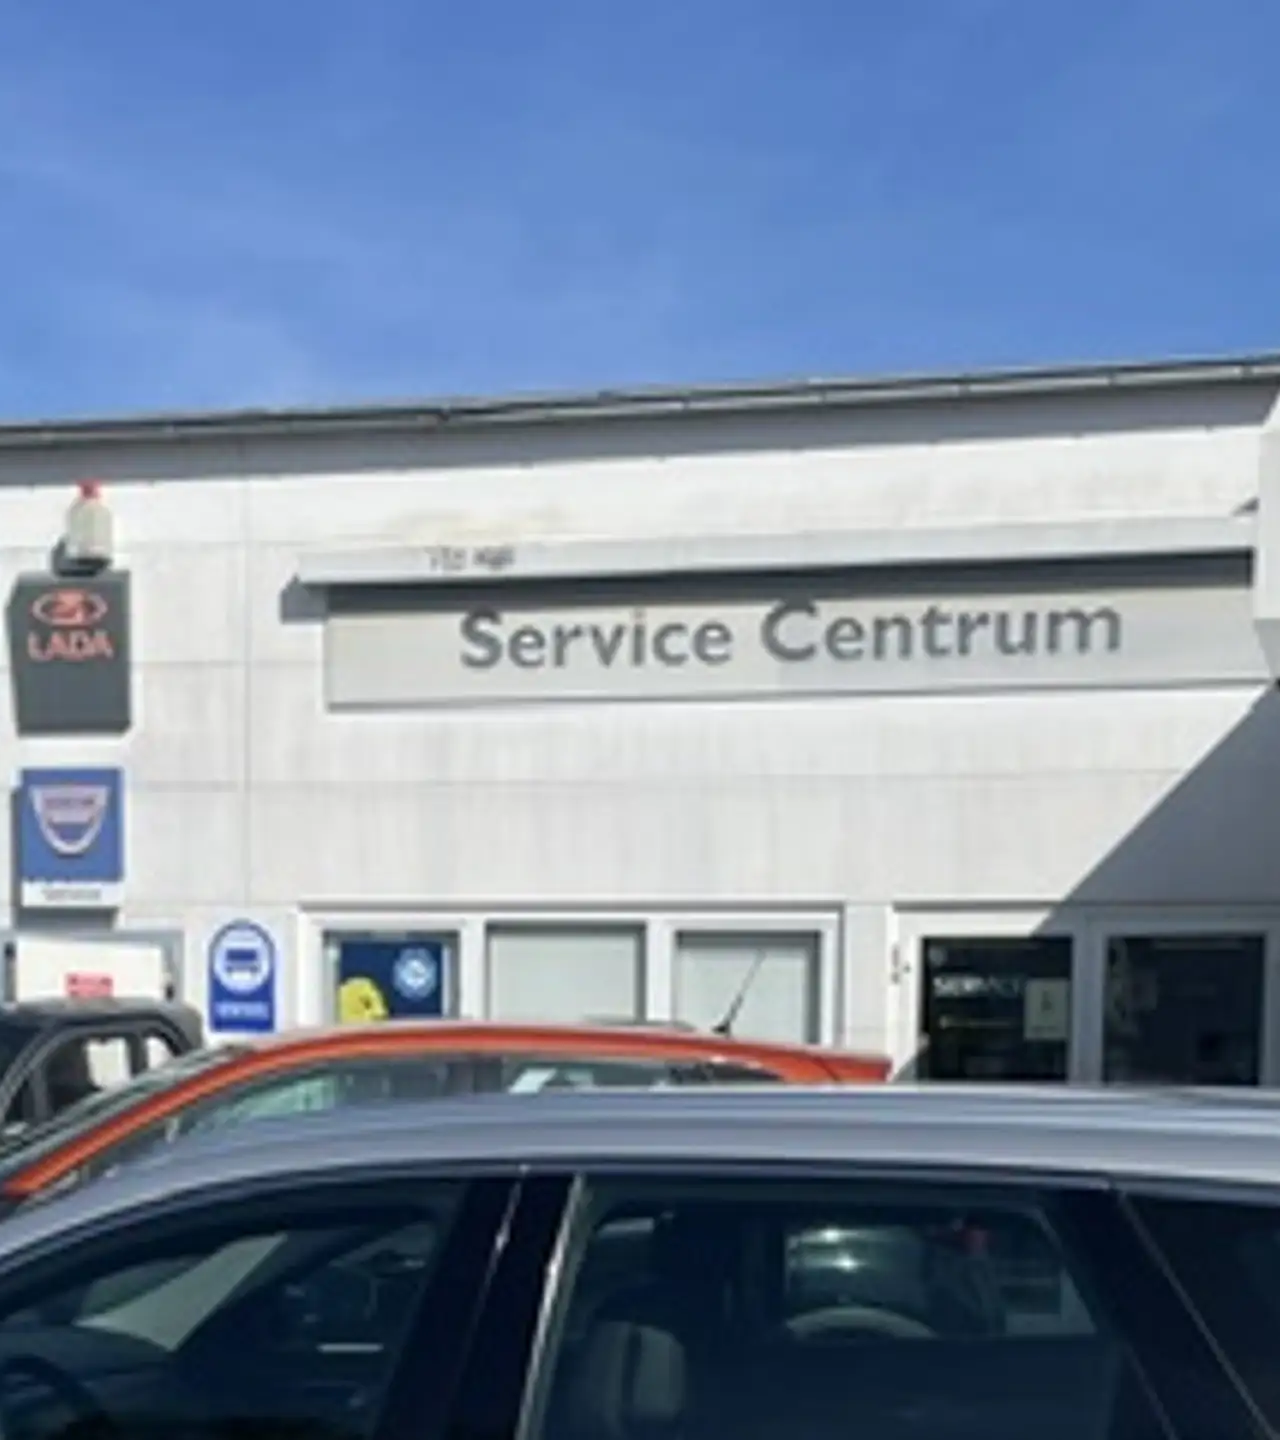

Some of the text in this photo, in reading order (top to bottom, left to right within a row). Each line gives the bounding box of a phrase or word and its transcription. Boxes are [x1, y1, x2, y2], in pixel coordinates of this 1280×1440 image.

[27, 629, 115, 662] LADA
[458, 598, 1123, 670] Service Centrum
